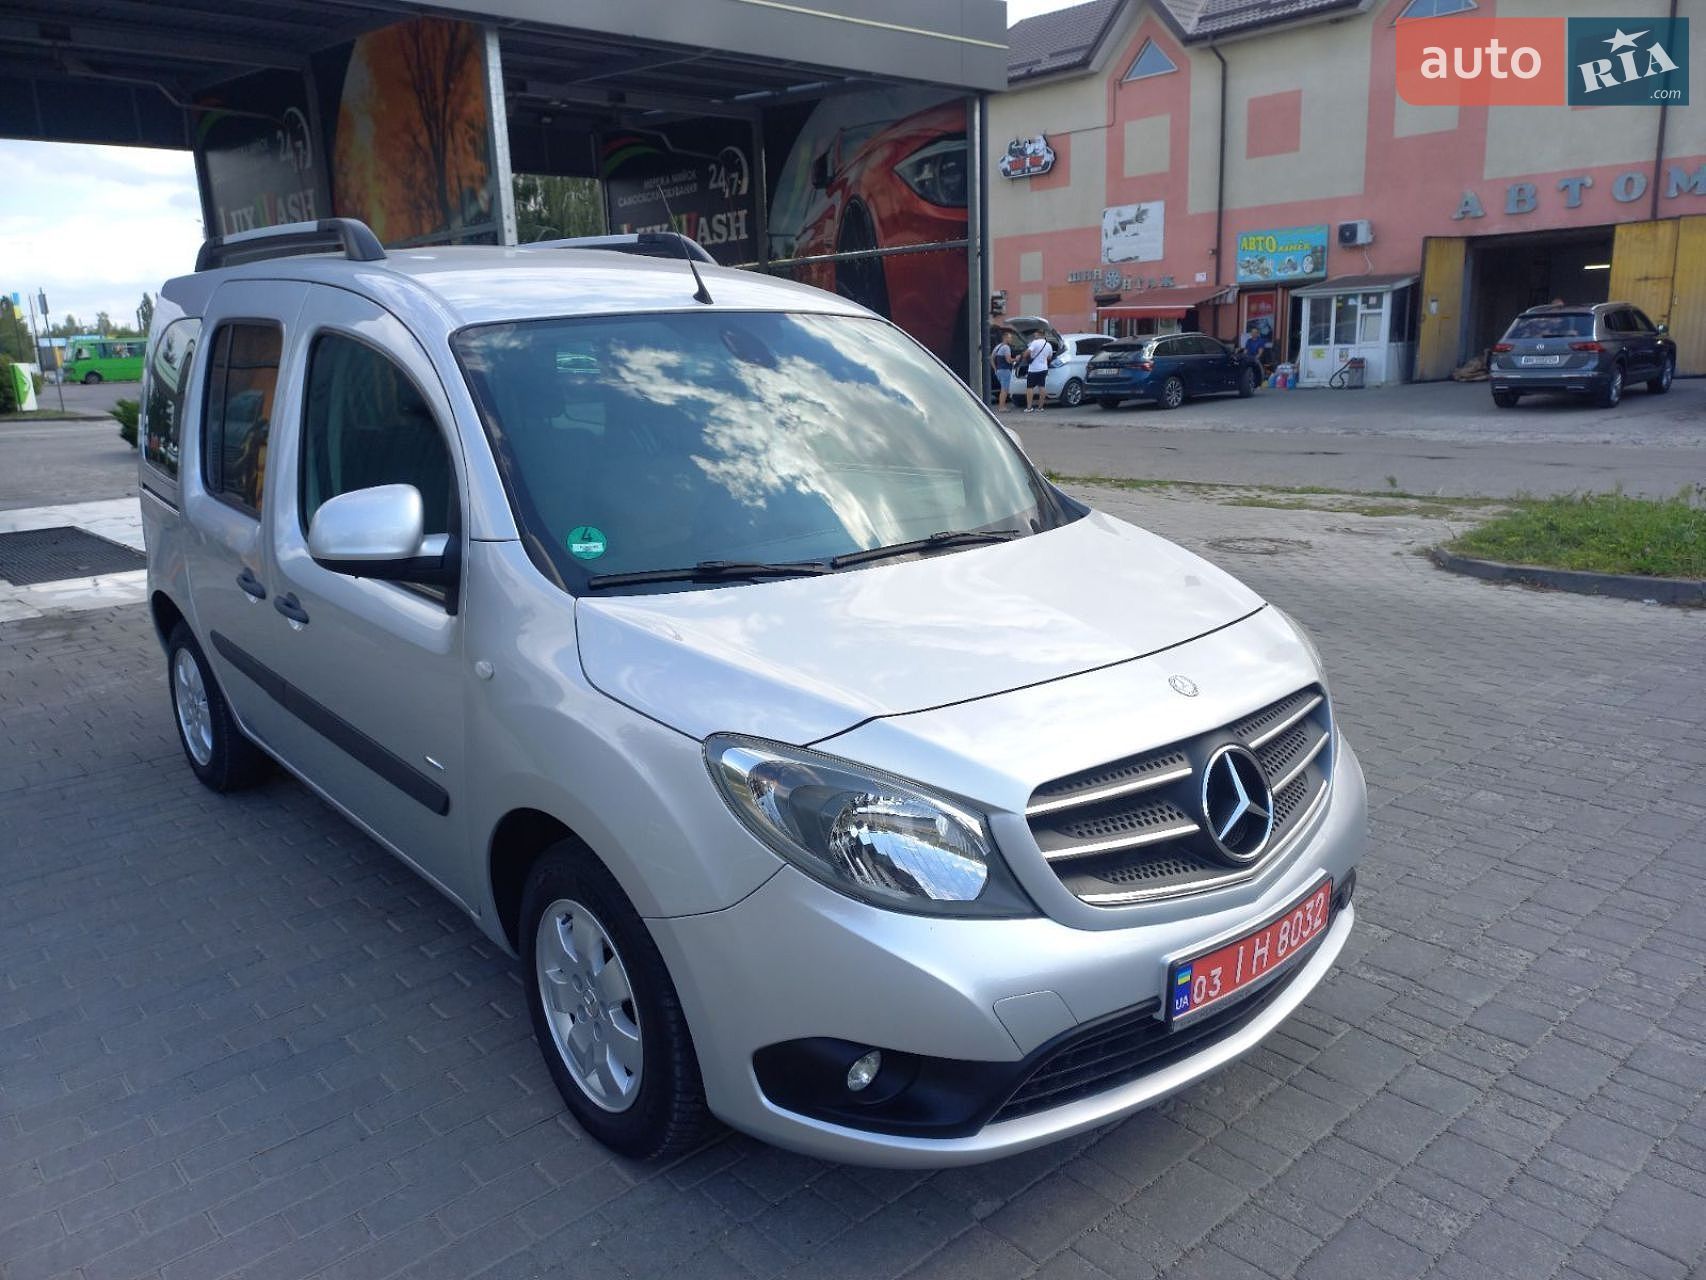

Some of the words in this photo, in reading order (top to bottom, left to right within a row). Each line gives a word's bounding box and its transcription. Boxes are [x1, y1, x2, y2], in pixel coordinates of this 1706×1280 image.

[1193, 966, 1222, 1003] 03
[1277, 892, 1325, 957] 8032
[1175, 996, 1189, 1010] UA
